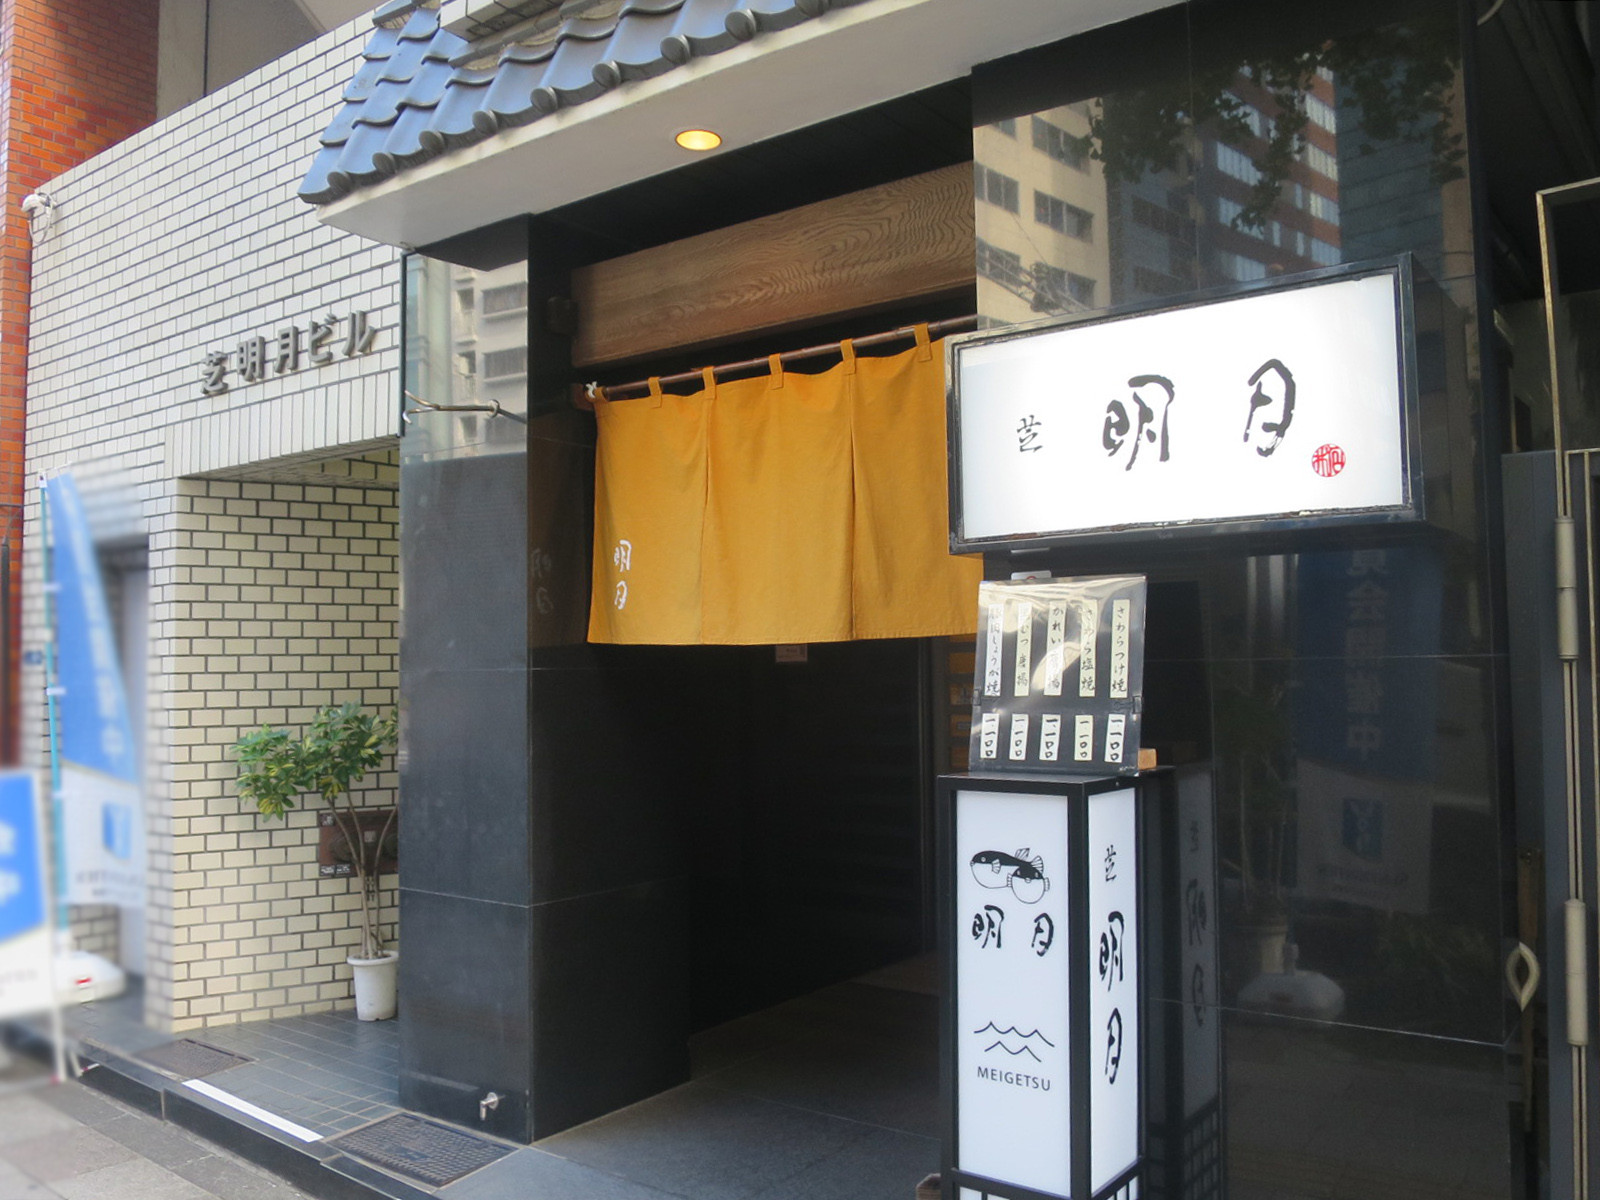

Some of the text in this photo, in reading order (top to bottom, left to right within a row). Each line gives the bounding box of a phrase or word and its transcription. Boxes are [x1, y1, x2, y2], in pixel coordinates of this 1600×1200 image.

[200, 310, 377, 395] 芝明月ビル
[614, 539, 632, 610] 明月
[1112, 607, 1126, 692] さわらつけ焼
[972, 904, 1055, 957] 明月
[977, 1065, 1052, 1091] MEIGETSU
